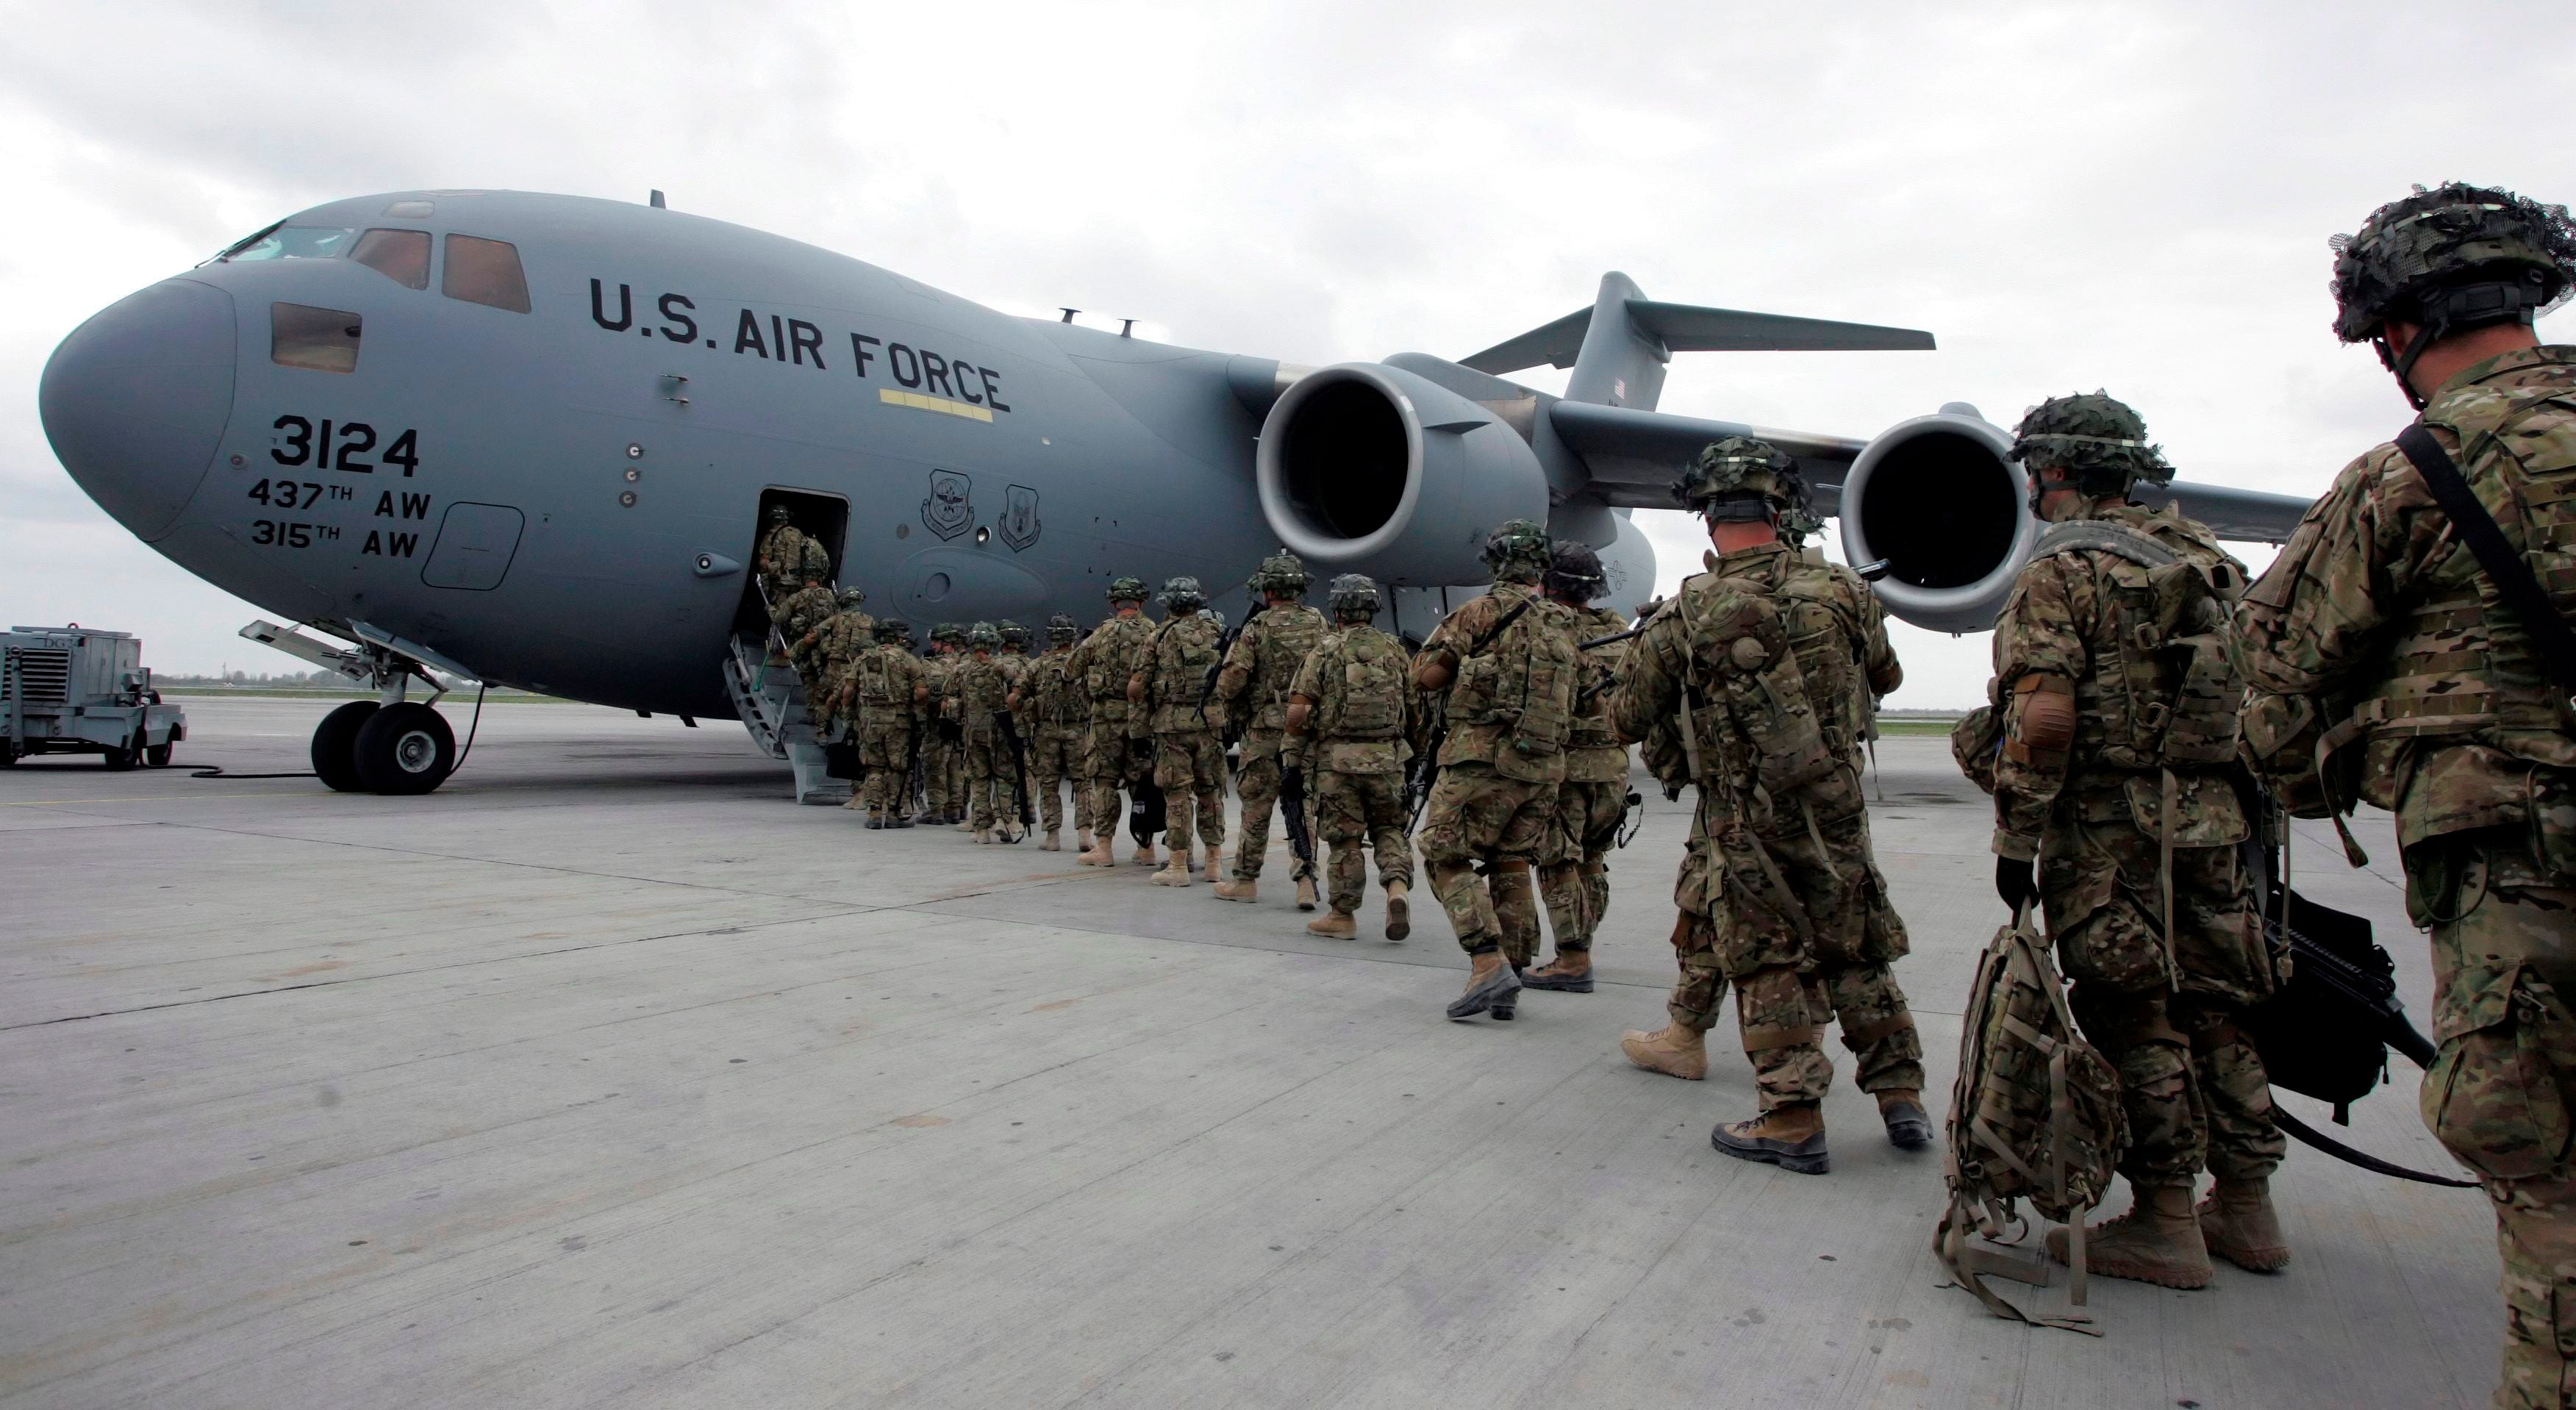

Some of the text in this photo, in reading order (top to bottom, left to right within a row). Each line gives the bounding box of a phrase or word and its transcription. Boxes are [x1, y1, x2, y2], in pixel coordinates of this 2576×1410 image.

[591, 278, 1011, 413] U.S. AIR FORCE
[271, 415, 419, 478] 3124
[248, 479, 431, 520] 437TH AW
[251, 520, 418, 558] 315TH AW
